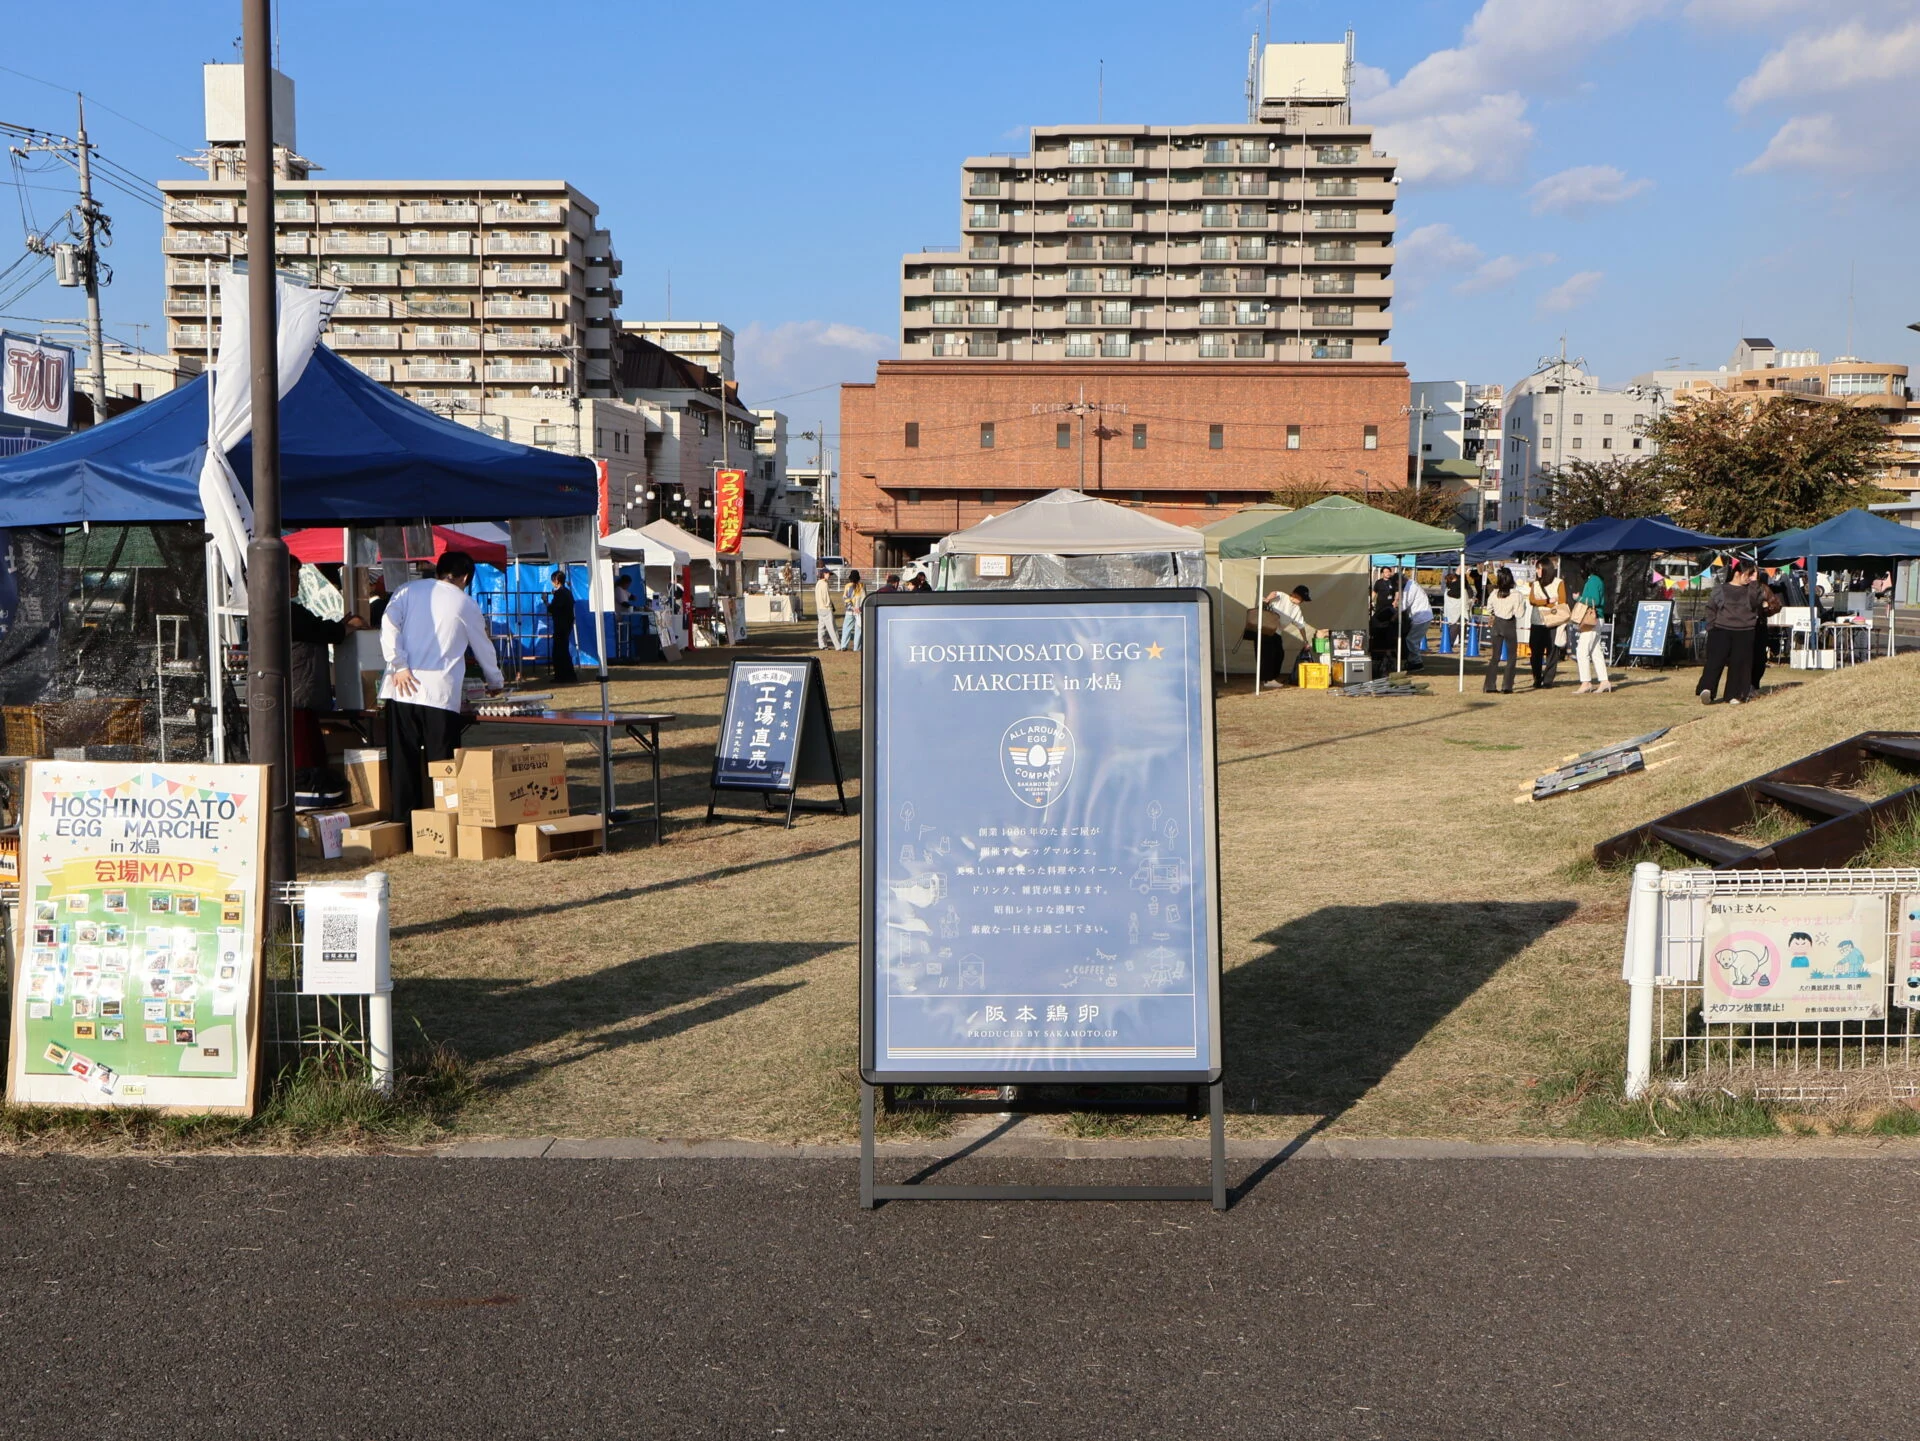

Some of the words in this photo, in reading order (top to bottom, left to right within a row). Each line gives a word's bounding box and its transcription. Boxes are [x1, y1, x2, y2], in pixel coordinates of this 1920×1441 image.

[720, 472, 740, 550] フライドポテト
[909, 643, 1084, 663] HOSHINOSATO
[1091, 642, 1142, 661] EGG
[952, 673, 1055, 692] MARCHE
[1063, 674, 1081, 691] in
[1085, 672, 1122, 692] 水島
[746, 686, 777, 770] 工場直売
[1009, 728, 1027, 741] ALL
[1027, 725, 1066, 740] AROUND
[1027, 735, 1048, 743] EGG
[1014, 766, 1061, 780] COMPANY
[50, 796, 236, 819] HOSHINOSATO
[56, 818, 102, 837] EGG
[124, 820, 219, 839] MARCHE
[110, 839, 124, 853] in
[129, 839, 160, 854] 水島
[94, 859, 195, 884] 会場MAP
[993, 904, 1086, 915] 昭和レトロな港町で
[1711, 903, 1777, 914] 飼い主さんへ
[970, 923, 1110, 935] 素敵な一日をお過ごし下さい。
[1072, 965, 1105, 976] COFFEE
[985, 1004, 1100, 1023] 阪本鶏卵
[967, 1029, 1023, 1038] PRODUCED
[1027, 1029, 1041, 1037] BY
[1043, 1029, 1119, 1037] SAKAMOTO.GP
